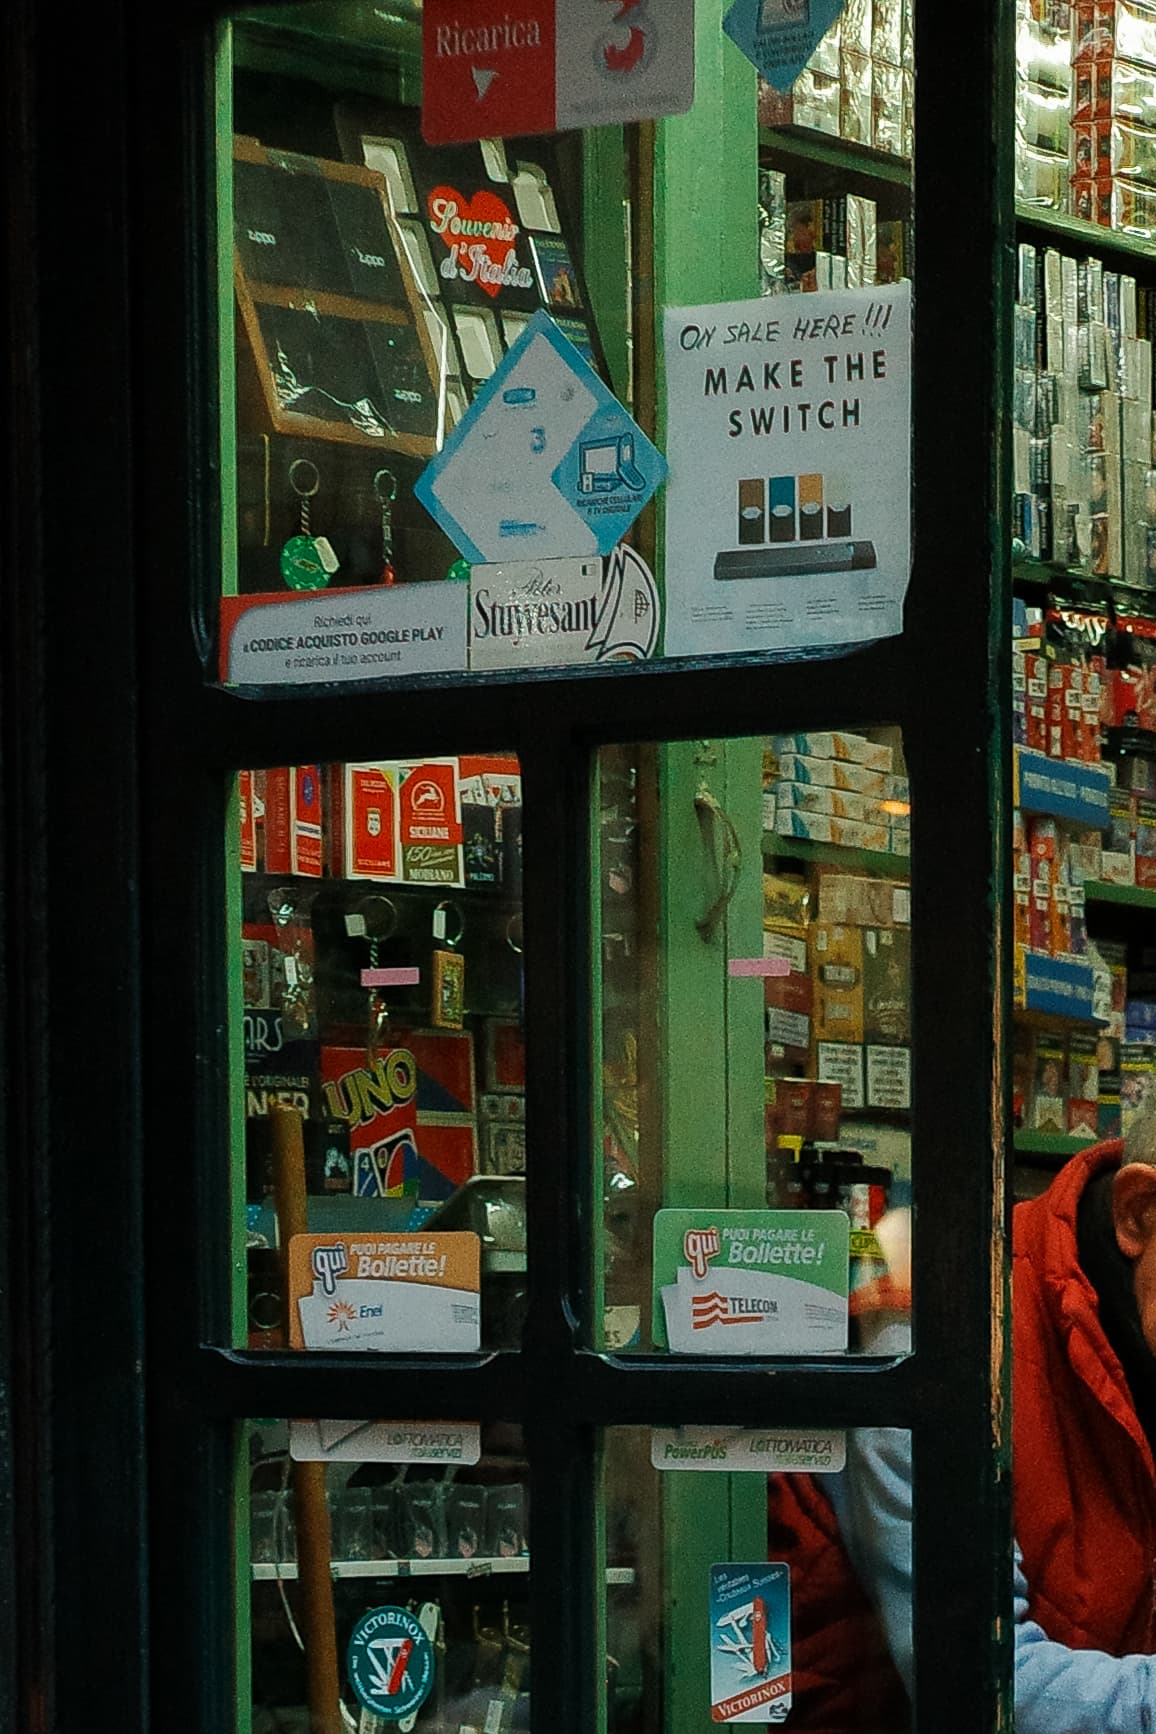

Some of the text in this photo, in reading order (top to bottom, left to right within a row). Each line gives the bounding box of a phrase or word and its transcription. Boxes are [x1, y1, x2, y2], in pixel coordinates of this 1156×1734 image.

[434, 14, 542, 57] Ricarica
[431, 199, 519, 241] Souvenir
[440, 244, 534, 288] d'Italia
[680, 324, 716, 350] ON
[723, 320, 779, 344] SALE
[793, 313, 856, 341] HERE
[703, 350, 887, 396] MAKE THE
[728, 398, 861, 438] SWITCH
[356, 613, 372, 630] qui
[474, 587, 600, 646] Stuyvesant
[250, 636, 295, 652] CODICE
[296, 632, 358, 650] ACQUISTO
[360, 630, 410, 646] GOOGLE
[411, 626, 444, 642] PLAY
[322, 1050, 417, 1127] UNO
[423, 1241, 436, 1254] LE
[722, 1228, 749, 1241] PUOI
[752, 1228, 798, 1241] PAGARE
[801, 1229, 815, 1241] LE
[357, 1254, 448, 1278] Bollette!
[728, 1242, 824, 1265] Bollette!
[360, 1304, 383, 1319] Enel
[729, 1297, 778, 1313] TELECOM
[353, 1611, 426, 1647] VICTORINOX
[718, 1681, 786, 1718] VICTORINOX
